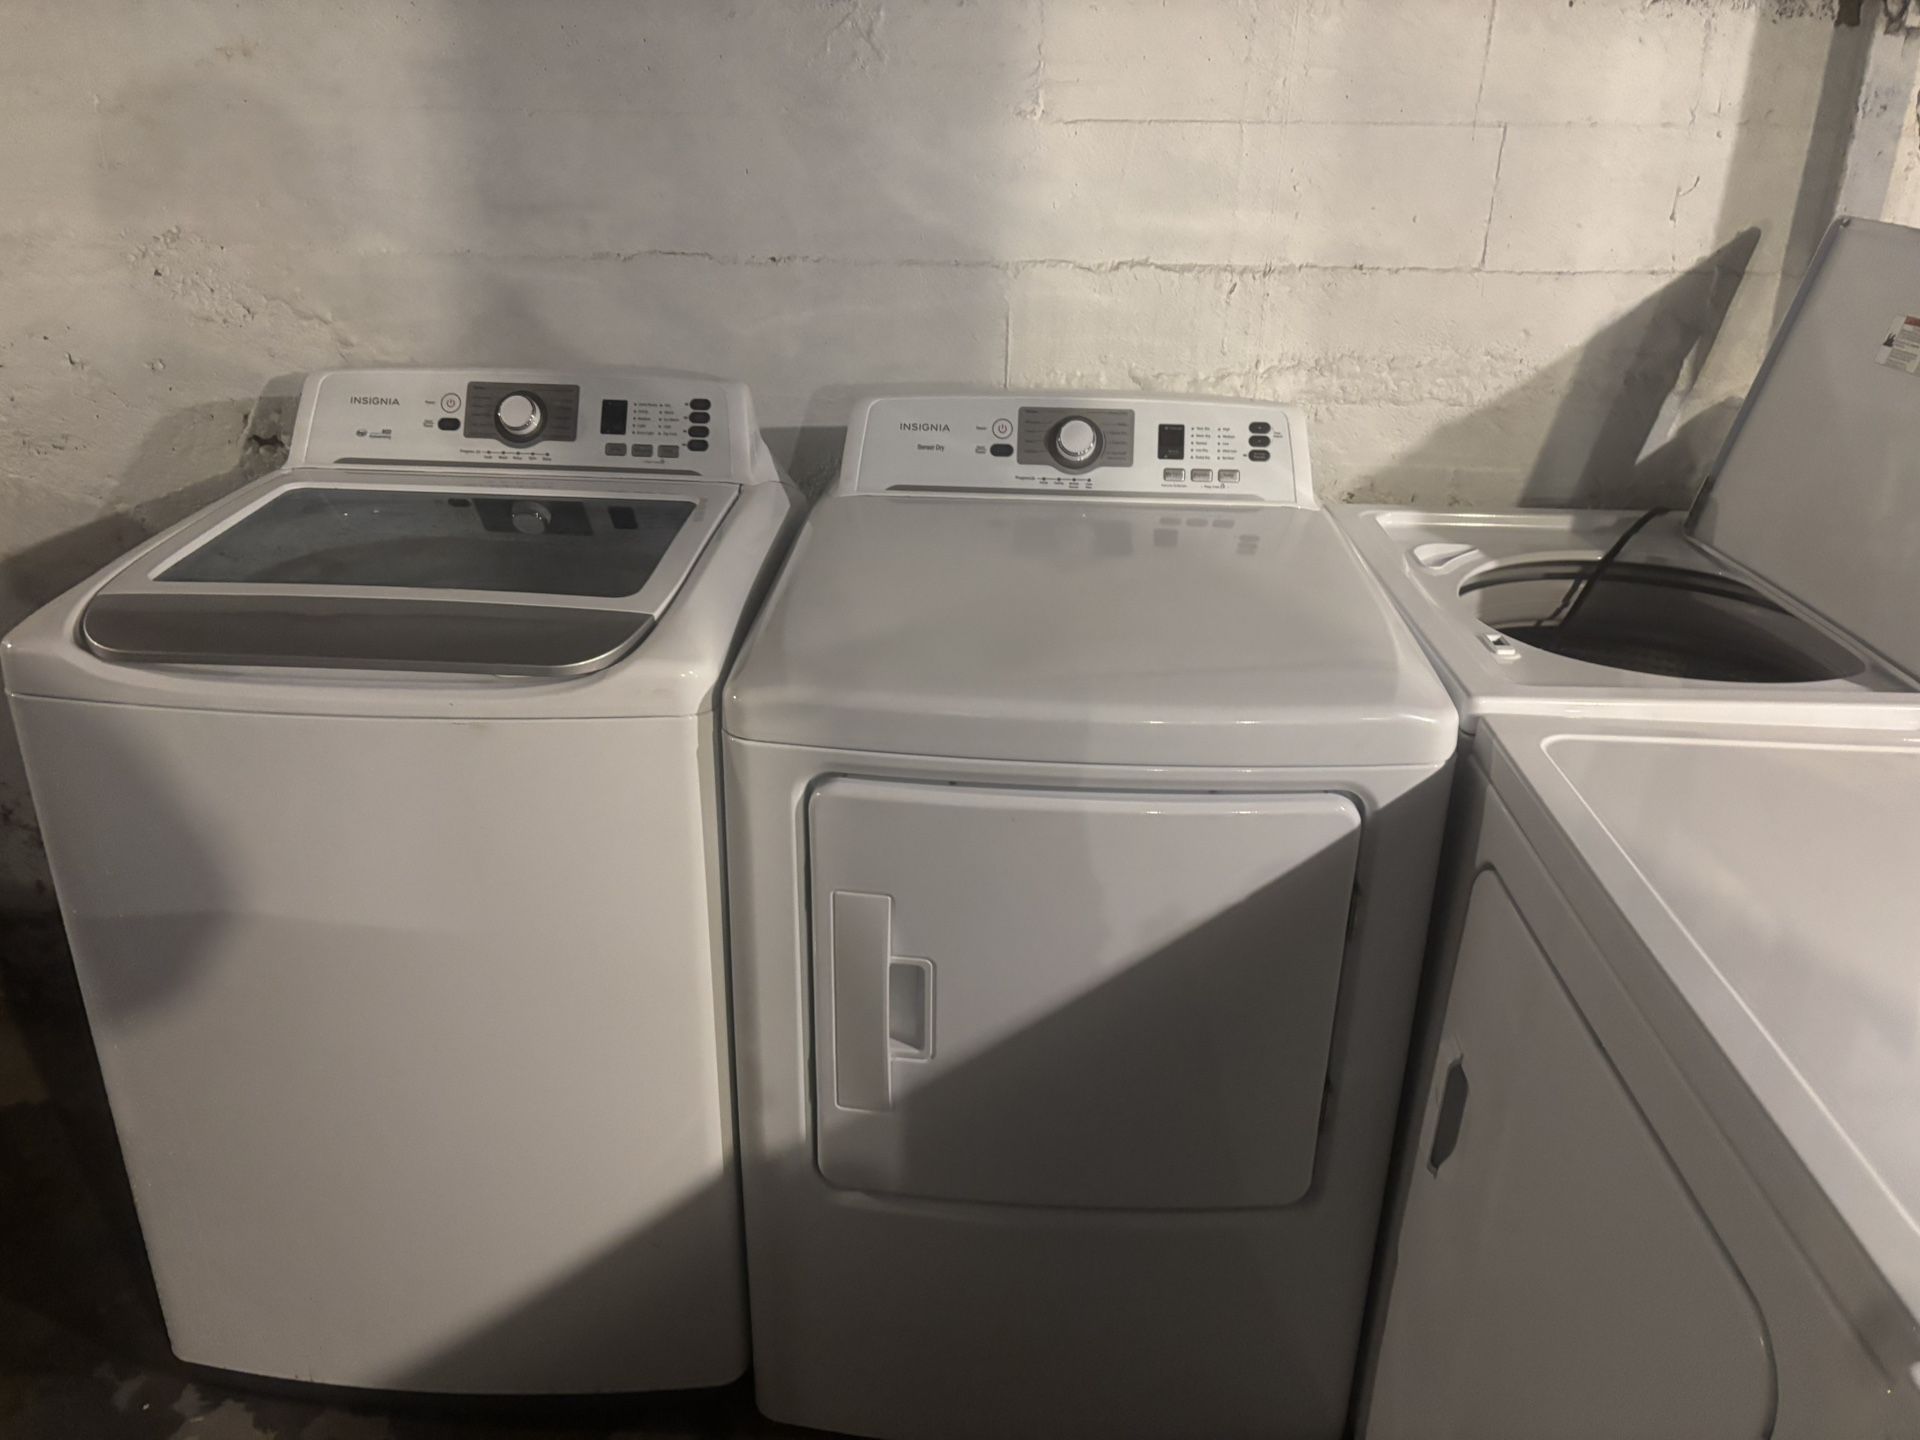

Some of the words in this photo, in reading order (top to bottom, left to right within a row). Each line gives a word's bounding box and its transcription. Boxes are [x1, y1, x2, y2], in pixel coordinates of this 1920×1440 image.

[350, 396, 400, 406] INSIGNIA
[899, 423, 951, 432] INSIGNIA
[935, 444, 945, 453] Dry
